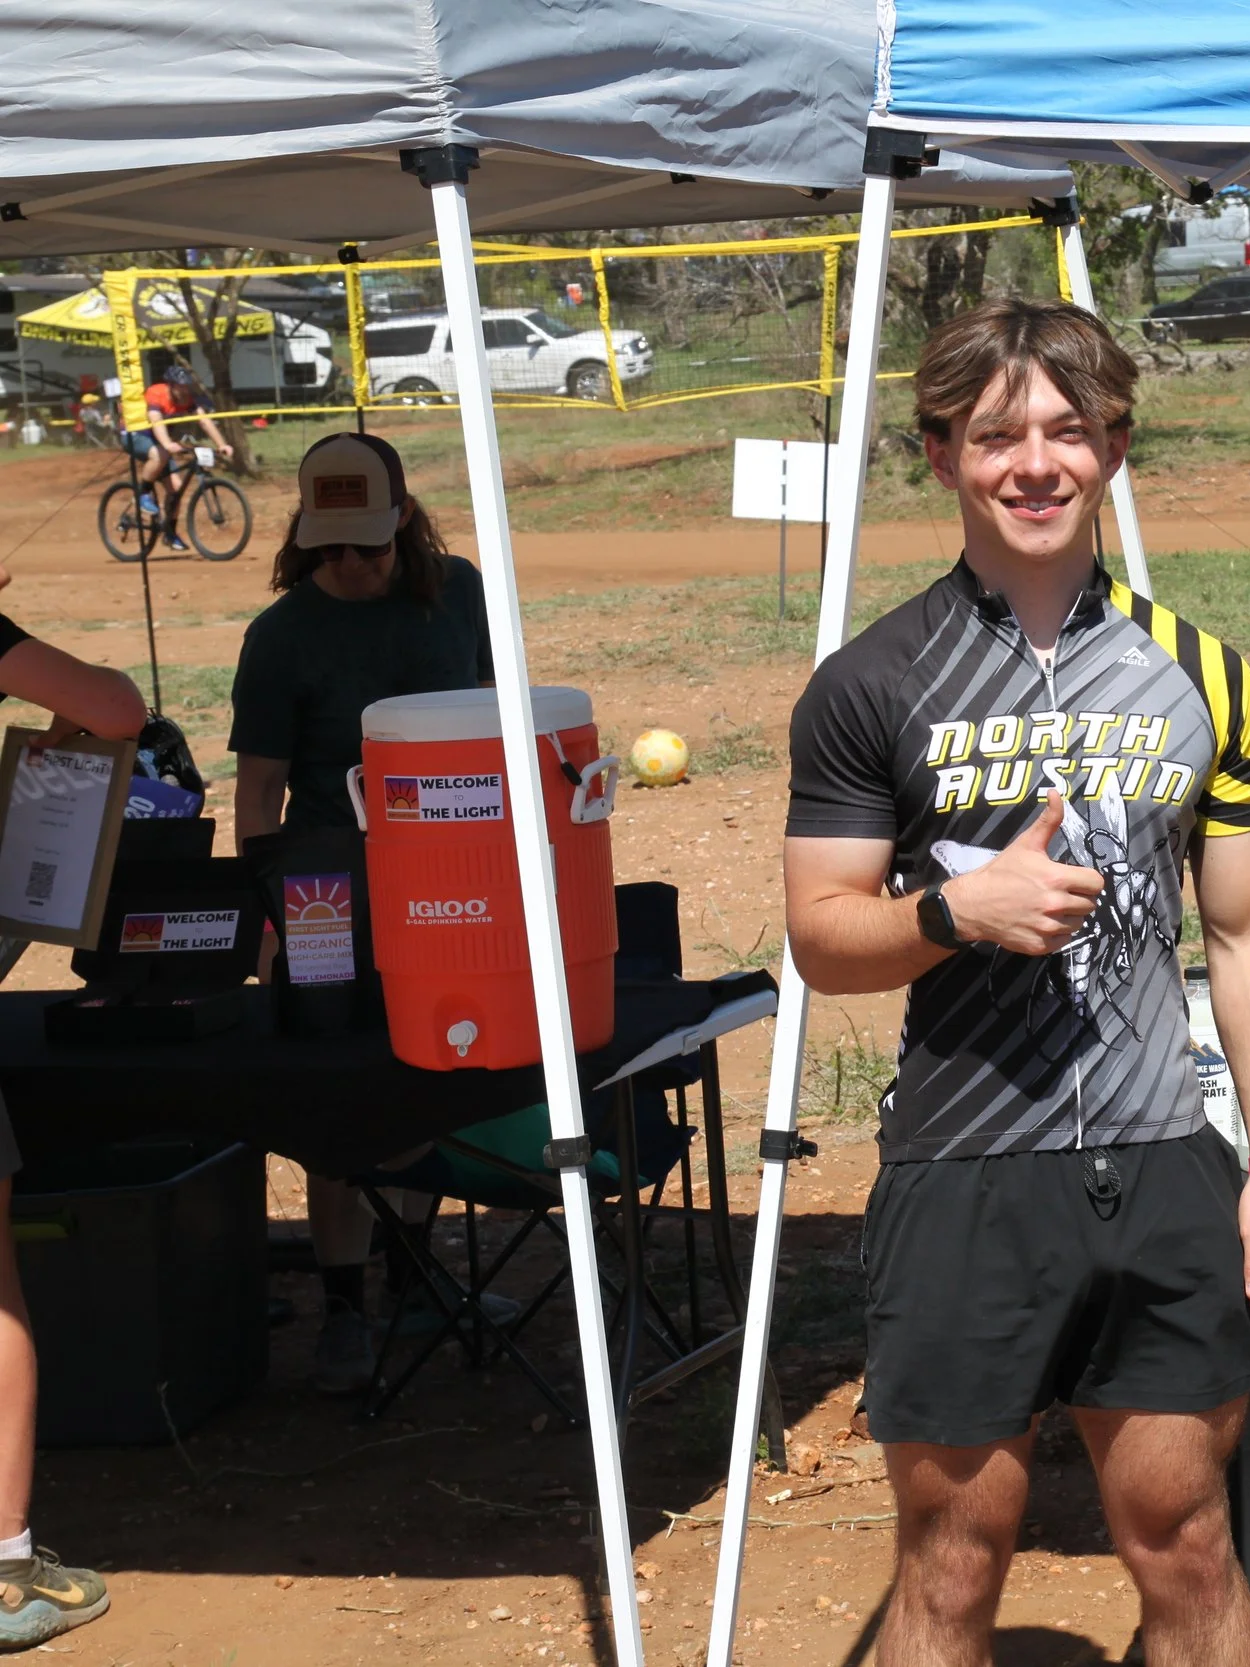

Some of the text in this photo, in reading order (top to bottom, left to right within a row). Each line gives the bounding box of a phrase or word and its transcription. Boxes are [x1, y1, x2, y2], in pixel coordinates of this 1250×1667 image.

[1117, 656, 1150, 667] AGILE
[926, 710, 1171, 767] NORTH
[420, 775, 499, 790] WELCOME
[934, 756, 1196, 813] AUSTIN
[421, 807, 450, 819] THE
[454, 805, 500, 819] LIGHT
[408, 899, 487, 917] IGLOO
[166, 912, 235, 924] WELCOME
[465, 916, 493, 924] WATER
[163, 937, 232, 949] THE LIGHT
[287, 937, 352, 951] ORGANIC
[337, 950, 354, 958] MIX
[290, 971, 355, 982] PINK LEMONADE
[1209, 1063, 1226, 1073] WASH
[1200, 1080, 1217, 1088] ASH
